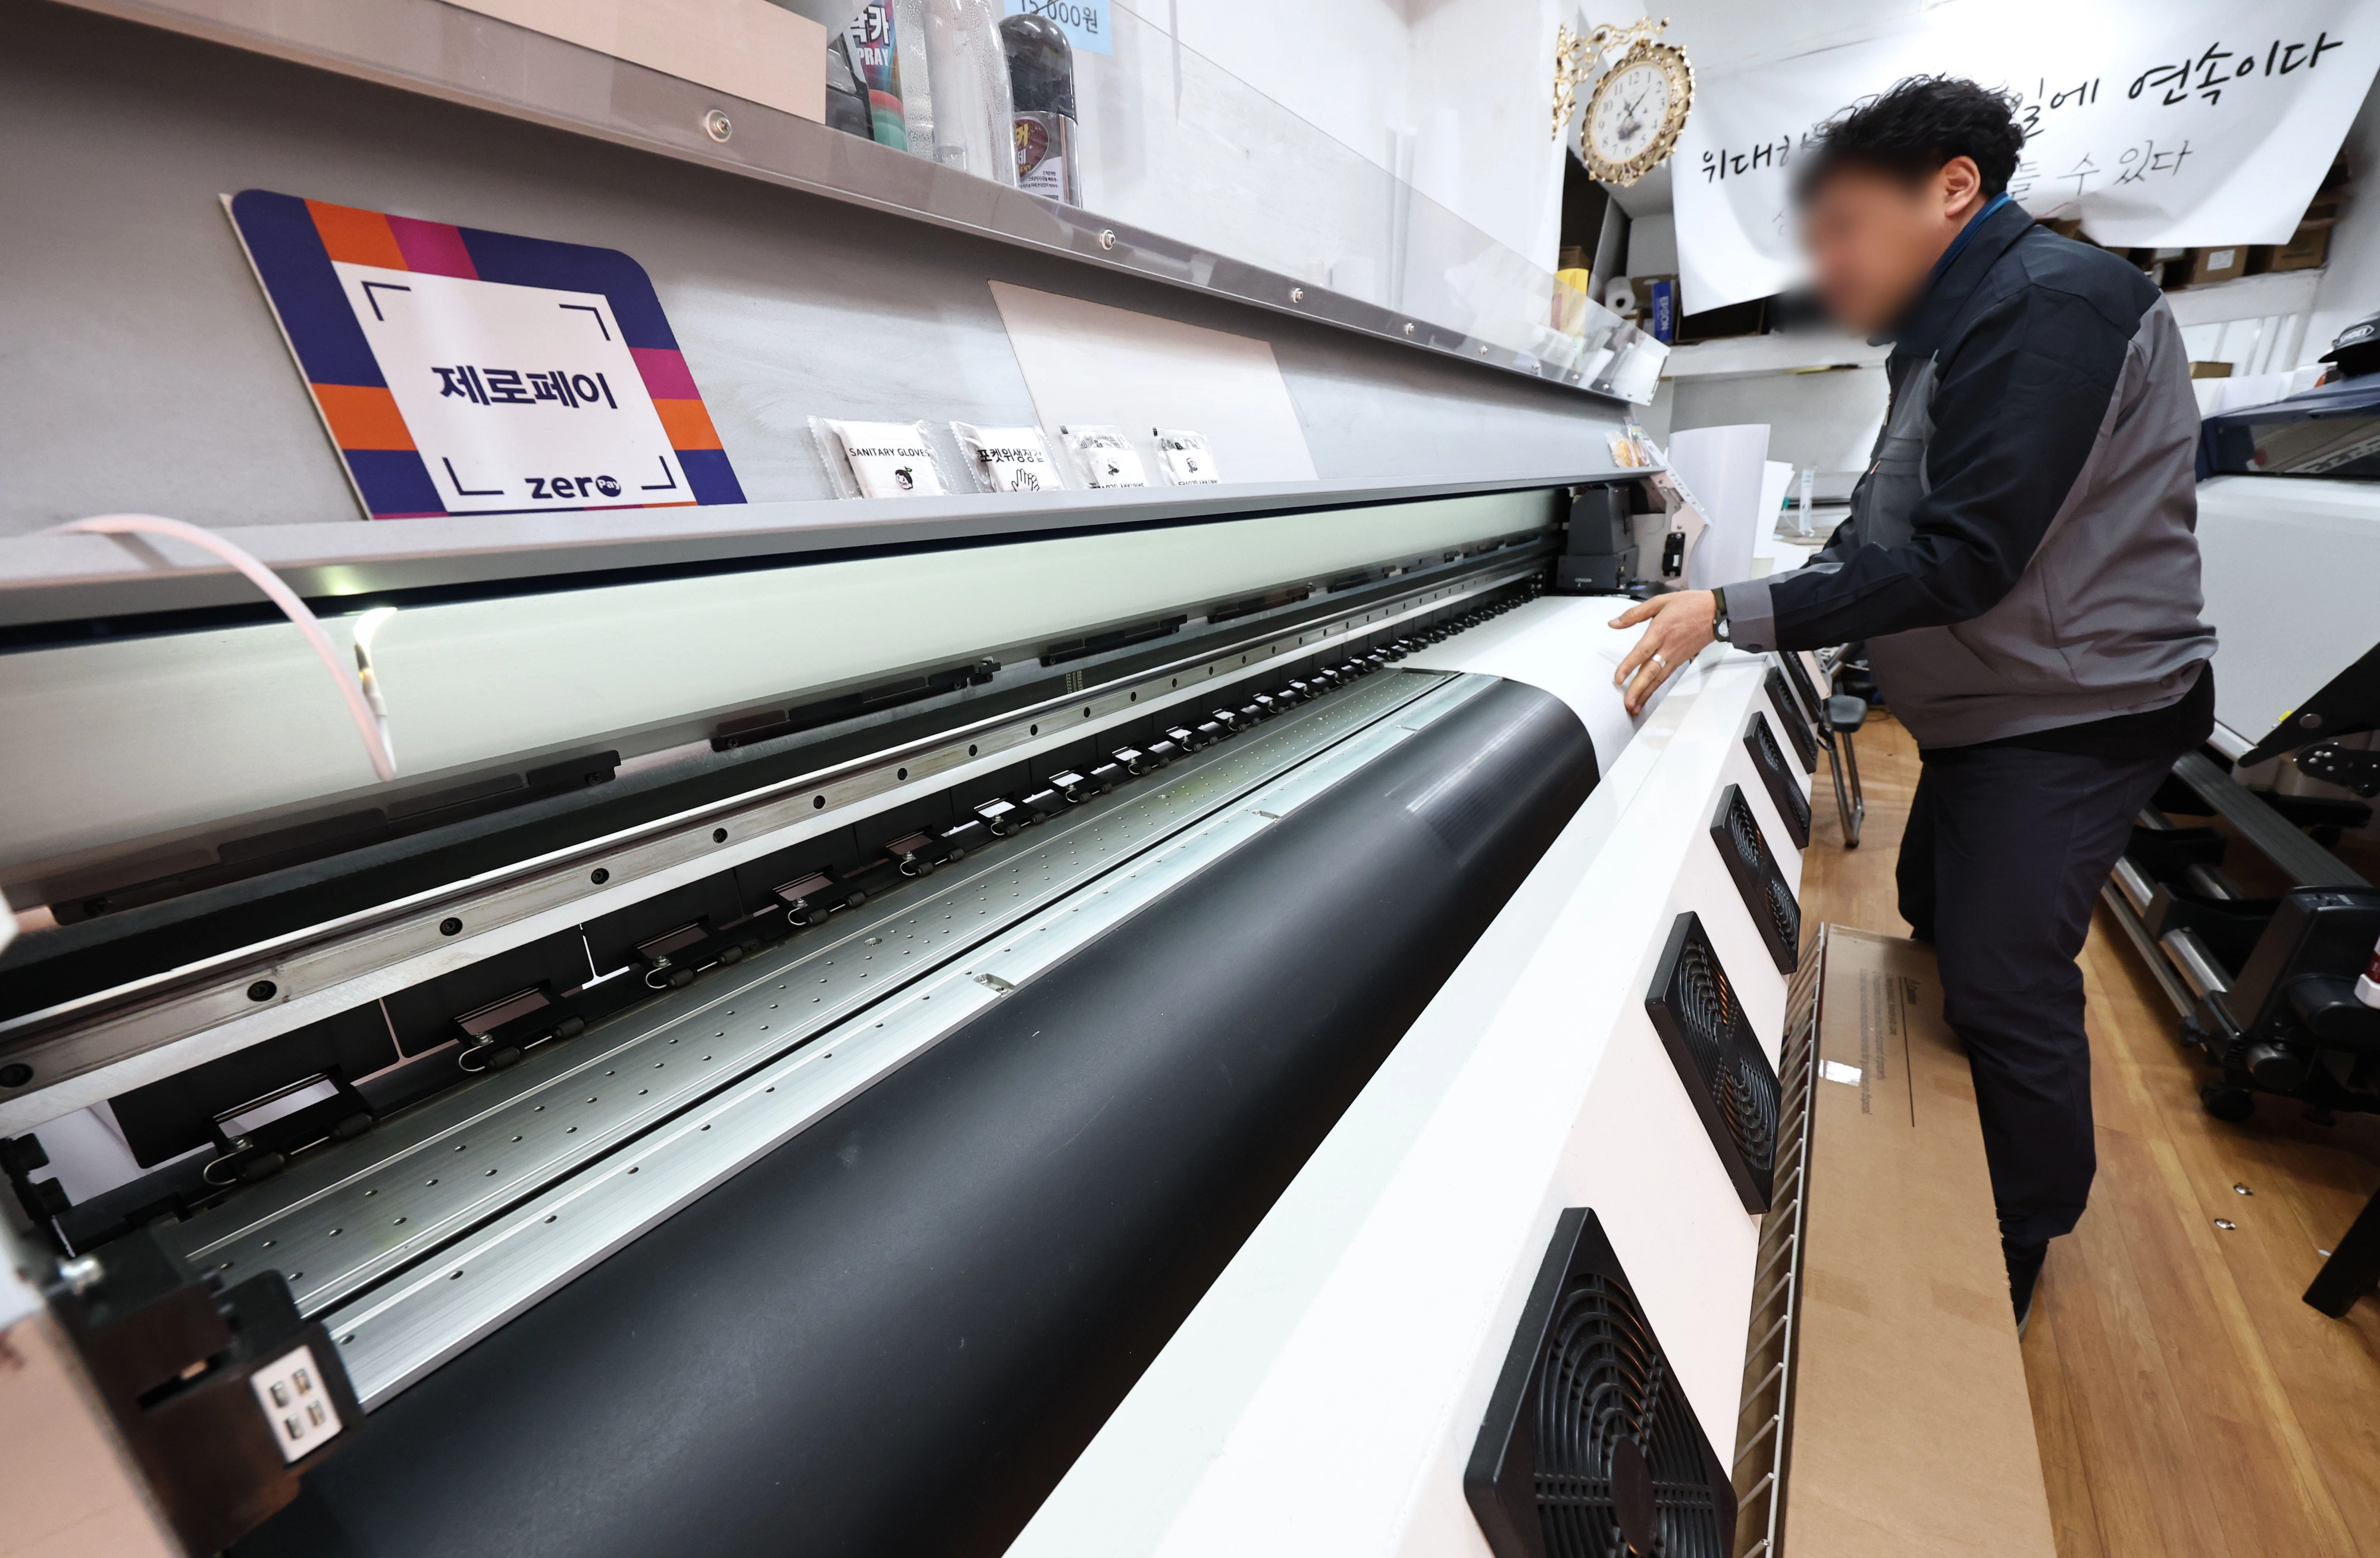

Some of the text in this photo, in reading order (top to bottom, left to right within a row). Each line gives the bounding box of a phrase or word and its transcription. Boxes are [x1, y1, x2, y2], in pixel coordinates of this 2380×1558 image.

[1021, 0, 1098, 34] 15000원
[857, 48, 889, 67] PRAY
[1629, 71, 1640, 86] 12
[2128, 32, 2345, 106] 연속이다
[1614, 82, 1624, 96] 11
[2056, 152, 2100, 197] 수
[2114, 139, 2194, 186] 있다
[431, 365, 618, 409] 제로페이
[849, 448, 930, 457] SANITARY GLOVES
[977, 448, 1044, 463] 포켓위생장갑
